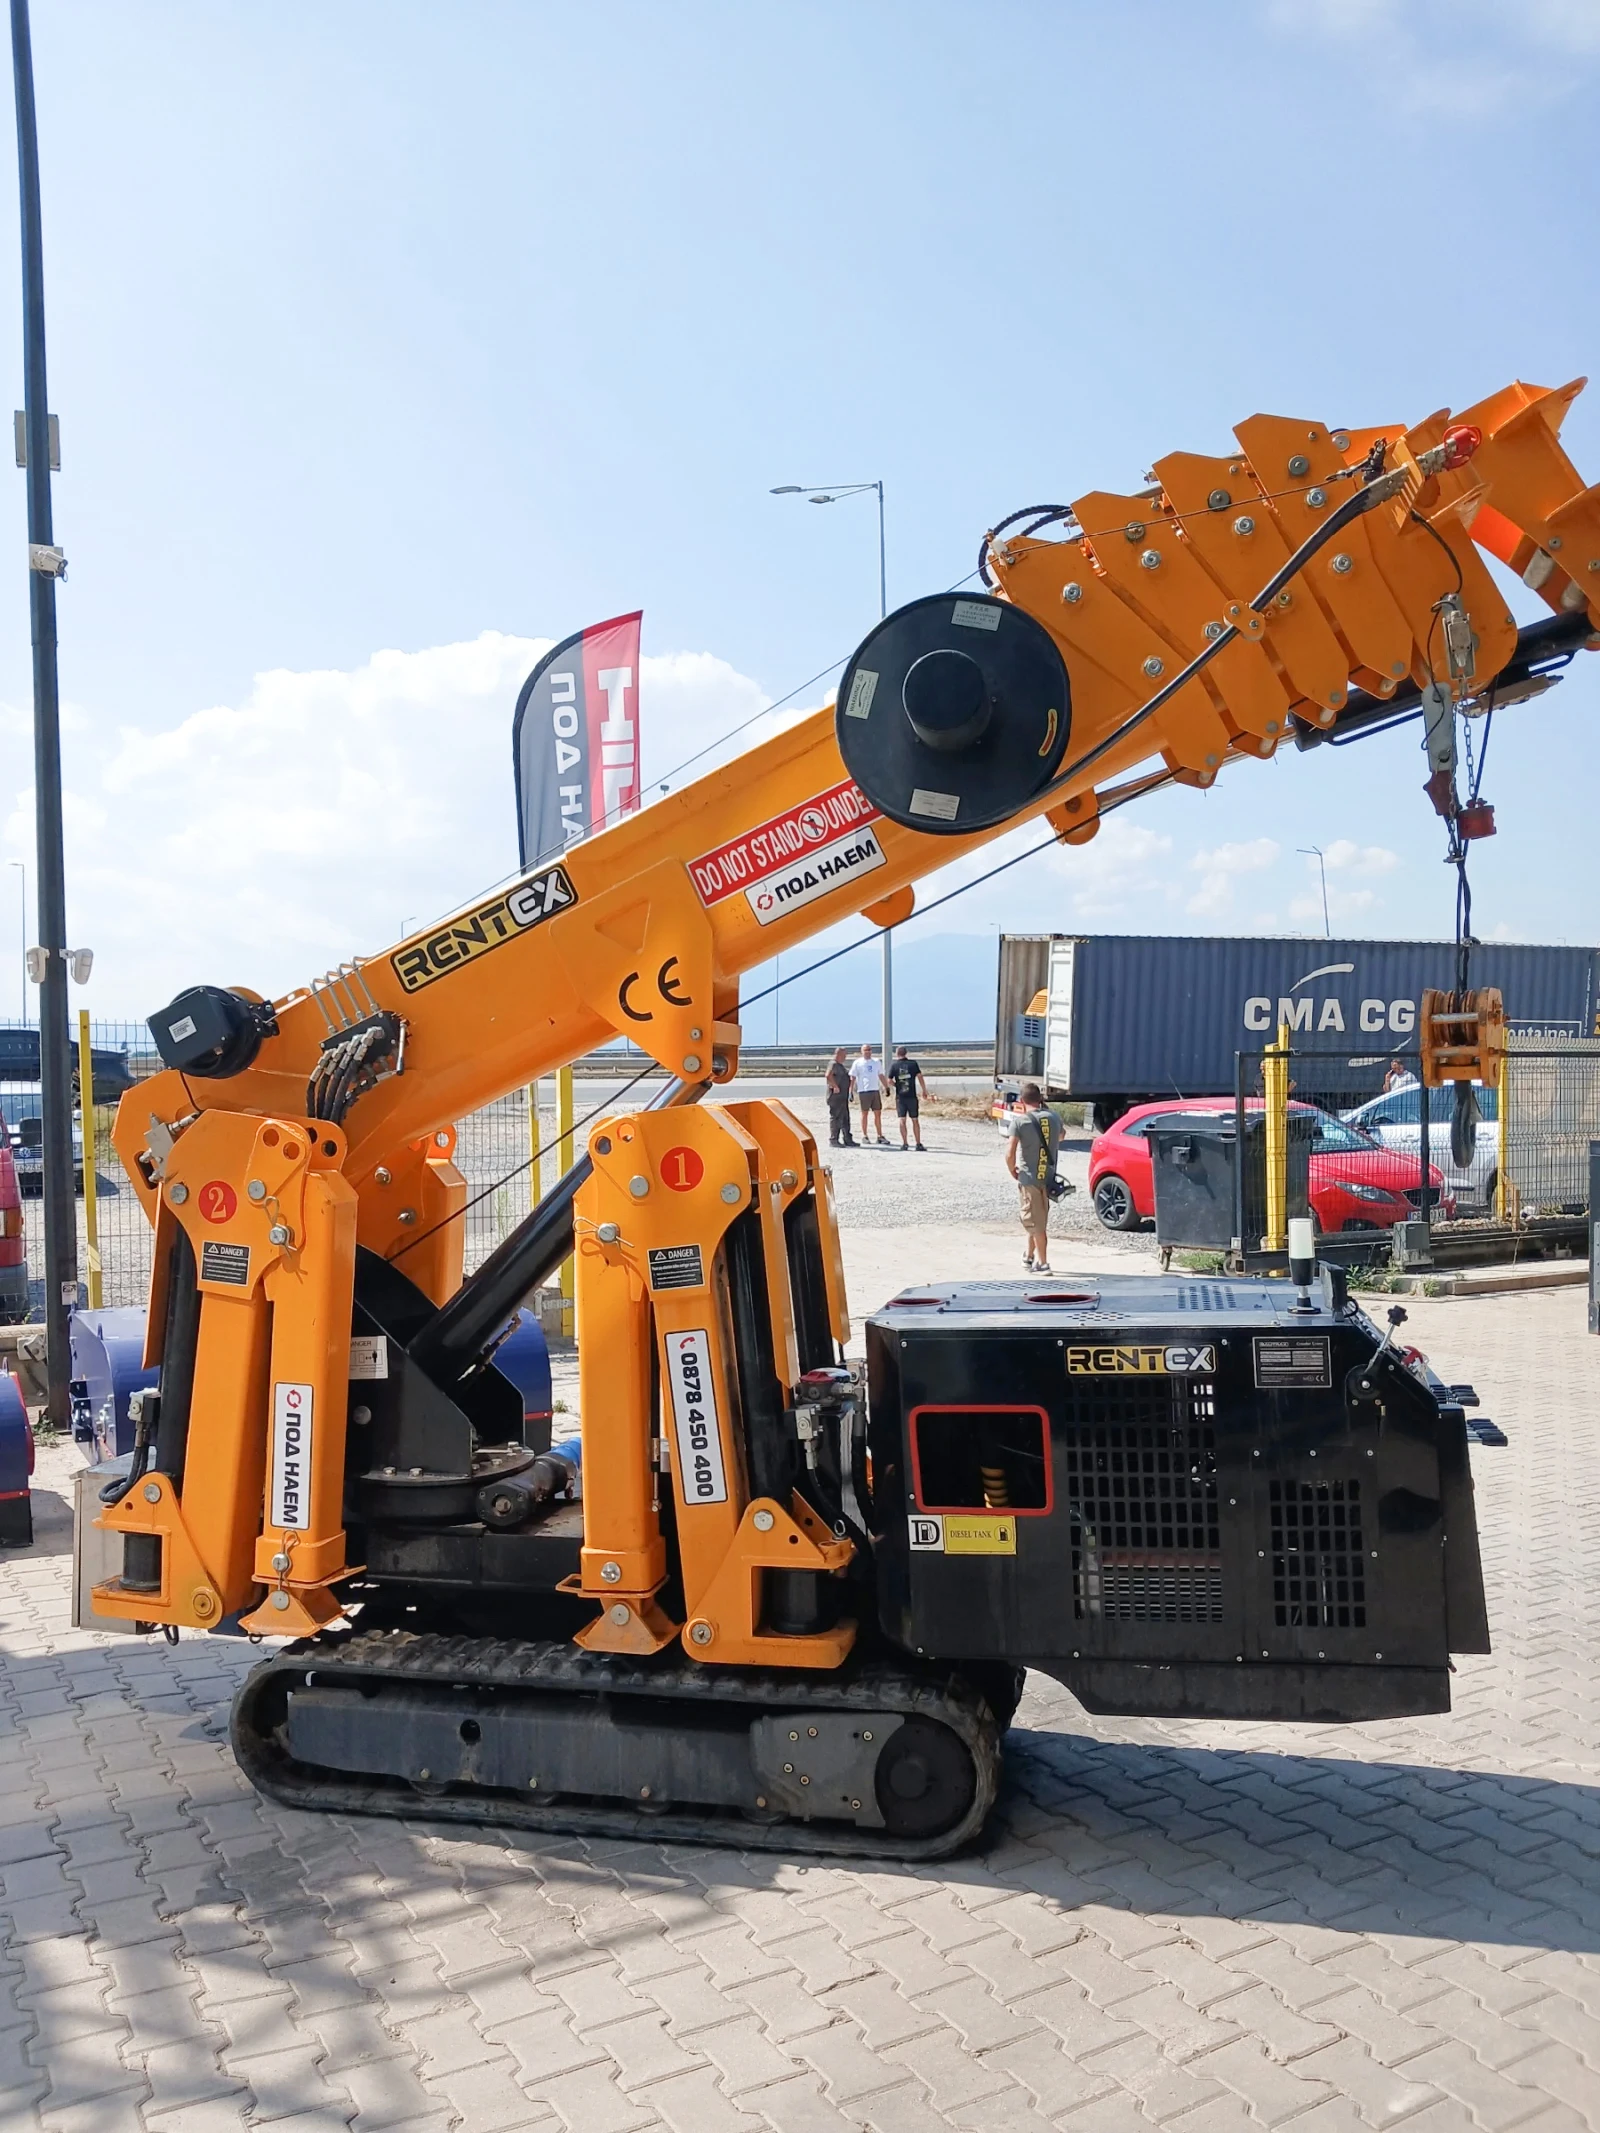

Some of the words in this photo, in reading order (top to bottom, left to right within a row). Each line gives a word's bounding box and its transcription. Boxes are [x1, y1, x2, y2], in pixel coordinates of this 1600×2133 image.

[550, 672, 581, 775] ПОД
[598, 666, 636, 830] HIL
[695, 861, 722, 896] DO
[718, 844, 754, 884] NOT
[751, 820, 805, 868] STAND
[775, 871, 819, 902] ПОД
[818, 839, 877, 879] НАЕМ
[398, 871, 570, 986] RENTEX
[618, 956, 693, 1021] CE
[1243, 997, 1345, 1032] CMA
[1359, 999, 1416, 1033] CG
[674, 1152, 693, 1187] 1
[208, 1186, 227, 1219] 2
[220, 1246, 244, 1256] DANGER
[668, 1248, 694, 1259] DANGER
[681, 1352, 703, 1404] 0878
[1070, 1347, 1213, 1371] RENTEX
[285, 1412, 301, 1457] ПОД
[688, 1408, 708, 1450] 450
[283, 1461, 300, 1523] НАЕМ
[694, 1455, 714, 1497] 400
[950, 1530, 972, 1539] DIESEL
[973, 1530, 993, 1539] TANK
